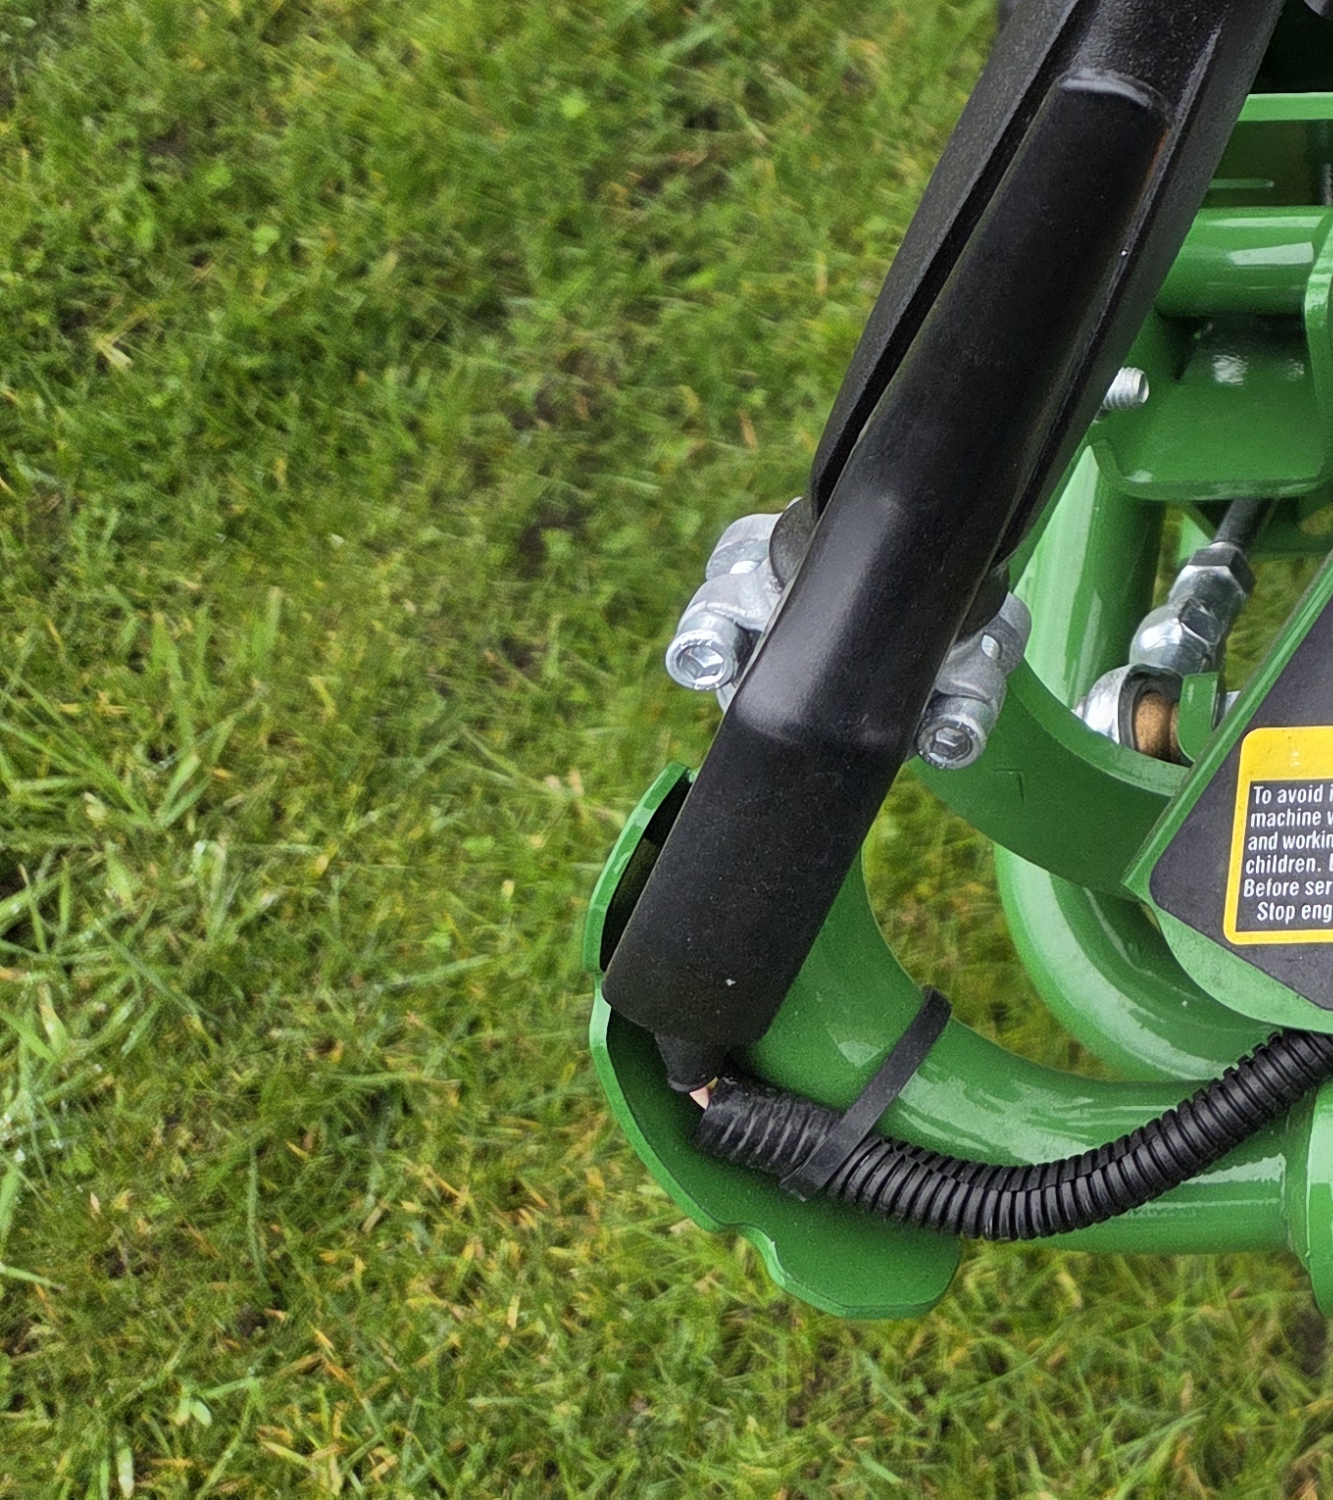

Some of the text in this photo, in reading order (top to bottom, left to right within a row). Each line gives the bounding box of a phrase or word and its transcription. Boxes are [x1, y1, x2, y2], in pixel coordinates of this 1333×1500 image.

[1253, 785, 1272, 805] To
[1276, 783, 1324, 804] avoid
[1250, 807, 1322, 828] machine
[1247, 830, 1278, 851] and
[1245, 853, 1322, 875] children.
[1243, 877, 1300, 898] Before
[1256, 900, 1296, 925] Stop
